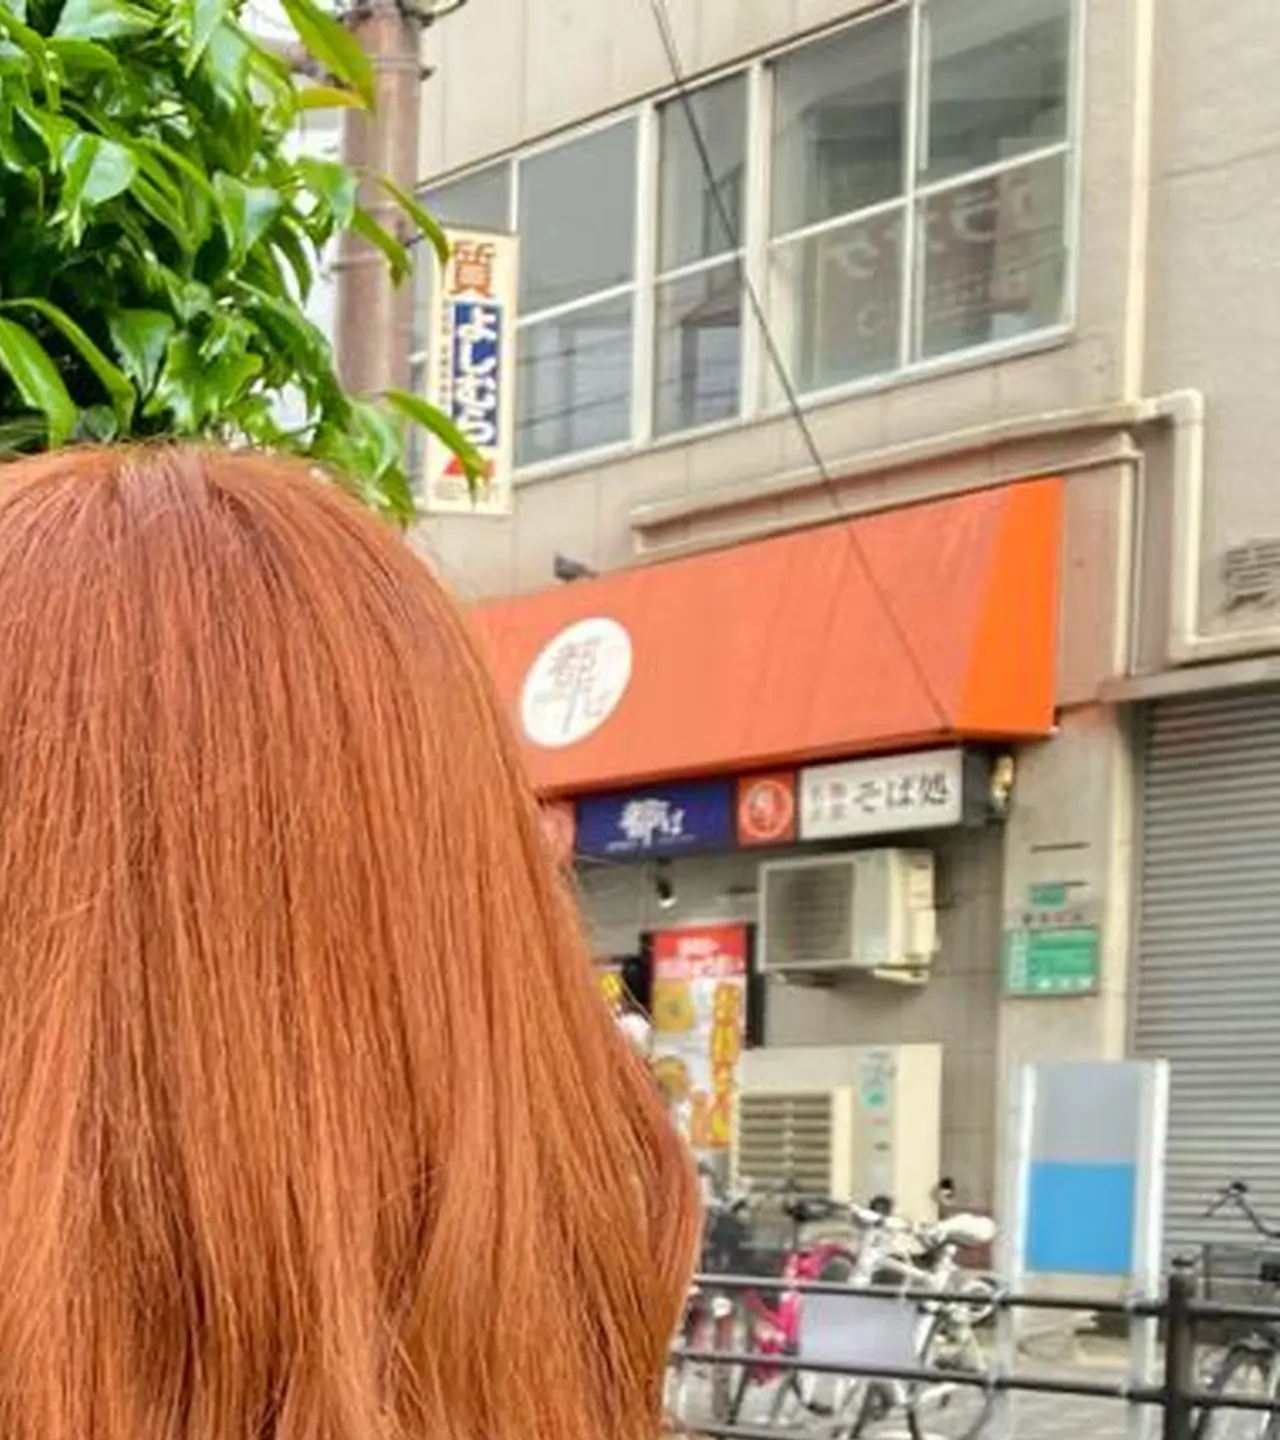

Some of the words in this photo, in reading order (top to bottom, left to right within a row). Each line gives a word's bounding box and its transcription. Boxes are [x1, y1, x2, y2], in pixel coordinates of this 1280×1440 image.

[450, 239, 495, 298] 質
[852, 768, 949, 813] そば処
